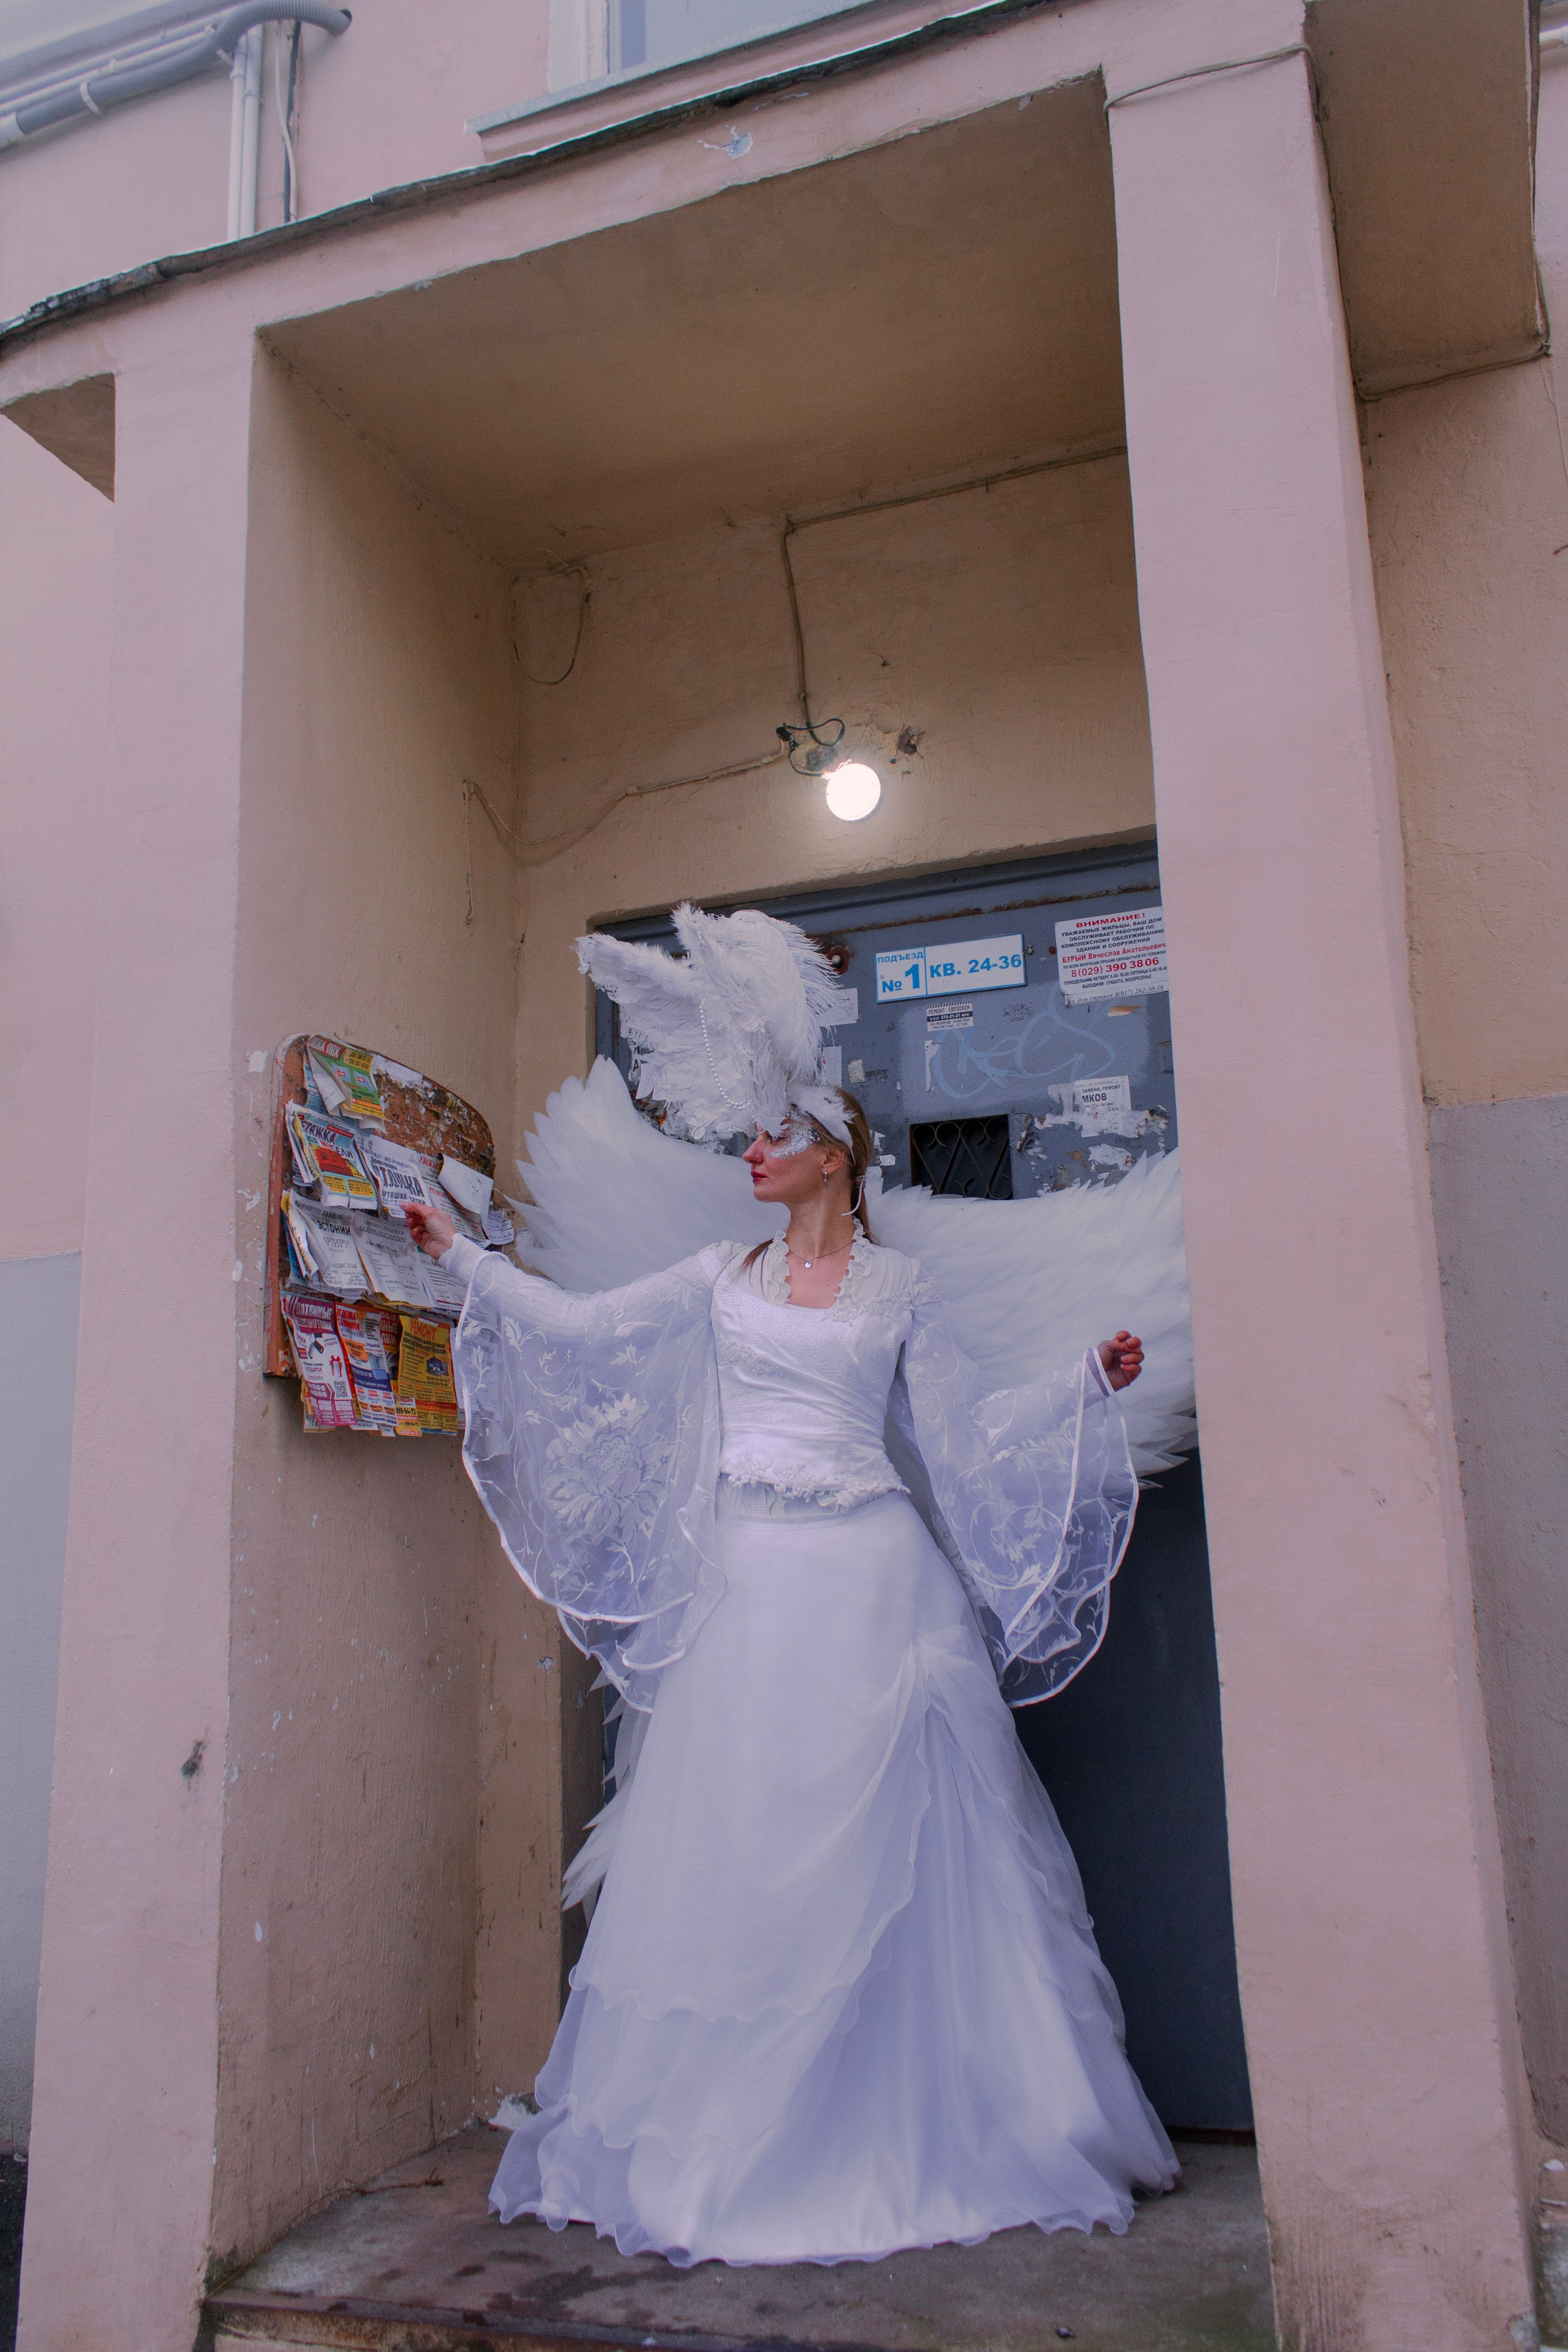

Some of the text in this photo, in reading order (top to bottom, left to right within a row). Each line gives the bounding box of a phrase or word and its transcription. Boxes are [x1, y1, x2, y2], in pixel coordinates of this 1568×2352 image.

[1061, 927, 1100, 937] УВАЖАЕМЫЕ
[1101, 922, 1131, 931] ЖИЛЬЦЫ,
[1069, 931, 1114, 941] ОБСЛУЖИВАЕТ
[1116, 925, 1144, 935] РАБОЧИЙ
[1061, 929, 1164, 949] КОМПЛЕКСНОМУ ОБСЛУЖИВАНИЮ
[1076, 944, 1101, 953] ЗДАНИЙ
[1108, 937, 1150, 948] СООРУЖЕНИЙ
[878, 952, 924, 963] ПОДЪЕЗД
[1062, 943, 1166, 963] БУРЫЙ Вячеслав Анатольевич
[1116, 954, 1140, 962] ОБРАЩАТЬСЯ
[930, 954, 1022, 978] КВ. 24-36
[1071, 965, 1103, 978] 8(029)
[1106, 962, 1127, 973] 390
[882, 963, 920, 993] № 1
[1135, 984, 1164, 993] 262-30-16
[317, 1221, 352, 1236] ЭСТОНИИ
